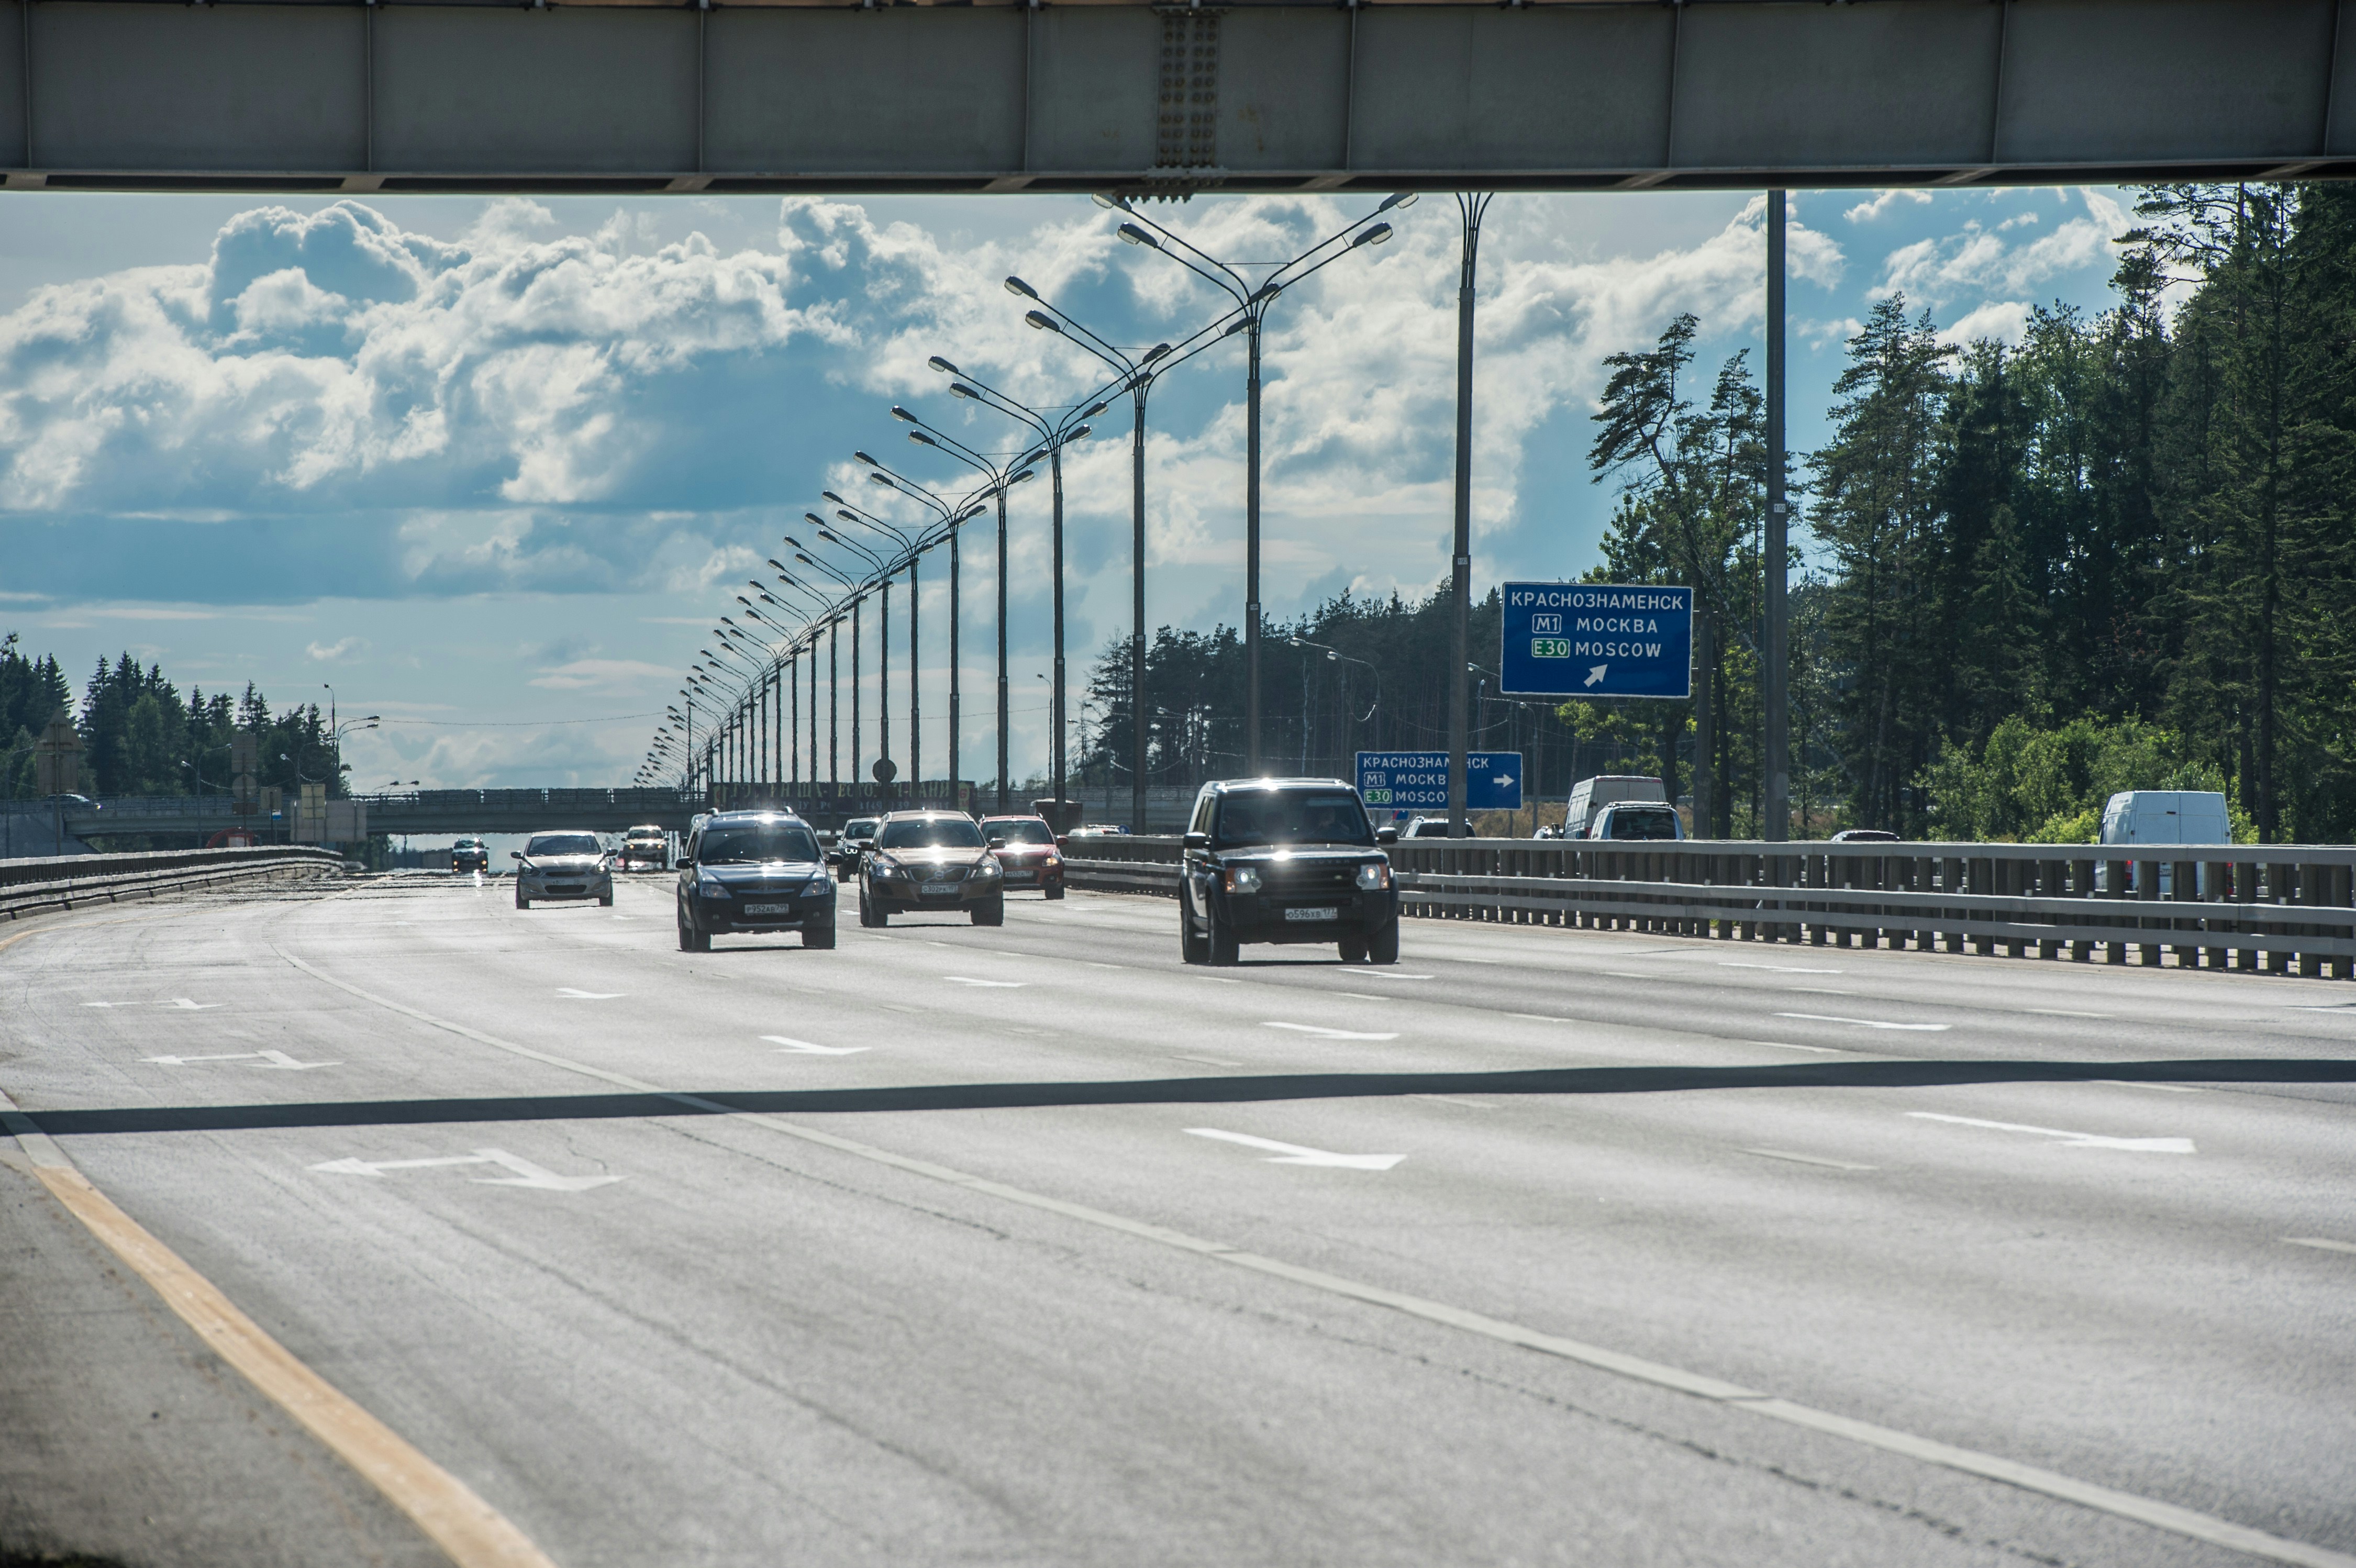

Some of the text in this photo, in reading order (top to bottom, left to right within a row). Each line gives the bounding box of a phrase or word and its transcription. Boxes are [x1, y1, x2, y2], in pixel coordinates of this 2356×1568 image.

[1512, 592, 1683, 609] КРАСНОЗНАМЕНСК
[1576, 618, 1658, 633] МОСКВА
[1533, 641, 1661, 657] E30 MOSCOW
[1395, 774, 1446, 785] МОСКВ
[1366, 791, 1449, 803] E30 MOSCO
